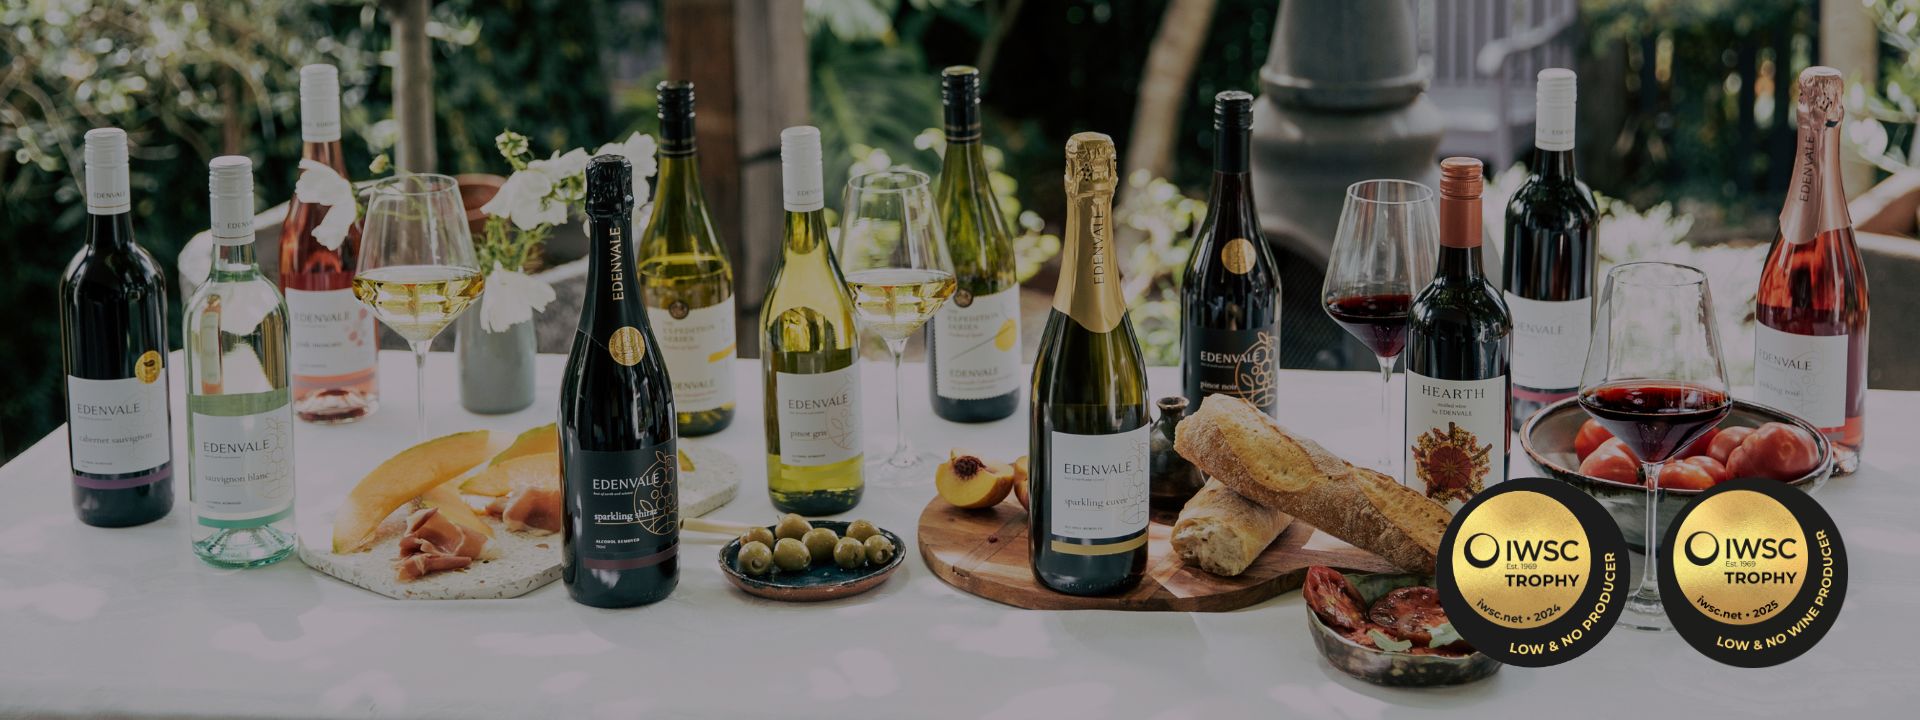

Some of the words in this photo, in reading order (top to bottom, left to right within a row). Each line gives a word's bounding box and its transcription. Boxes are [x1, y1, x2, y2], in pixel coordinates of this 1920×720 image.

[1800, 135, 1815, 202] EDENVALE
[1092, 209, 1104, 285] EDENVALE
[609, 226, 624, 301] EDENVALE
[1200, 351, 1261, 364] EDENVALE
[1422, 384, 1484, 400] HEARTH
[77, 402, 141, 416] EDENVALE
[787, 393, 849, 410] EDENVALE
[1440, 409, 1473, 417] EDENVALE
[112, 433, 152, 447] sauvignon
[203, 439, 270, 454] EDENVALE
[1064, 460, 1132, 476] EDENVALE
[205, 474, 246, 485] sauvignon
[248, 471, 271, 482] blanc
[592, 472, 661, 491] EDENVALE
[1064, 497, 1104, 510] sparkling
[594, 511, 633, 523] sparkling
[635, 508, 659, 520] shiraz
